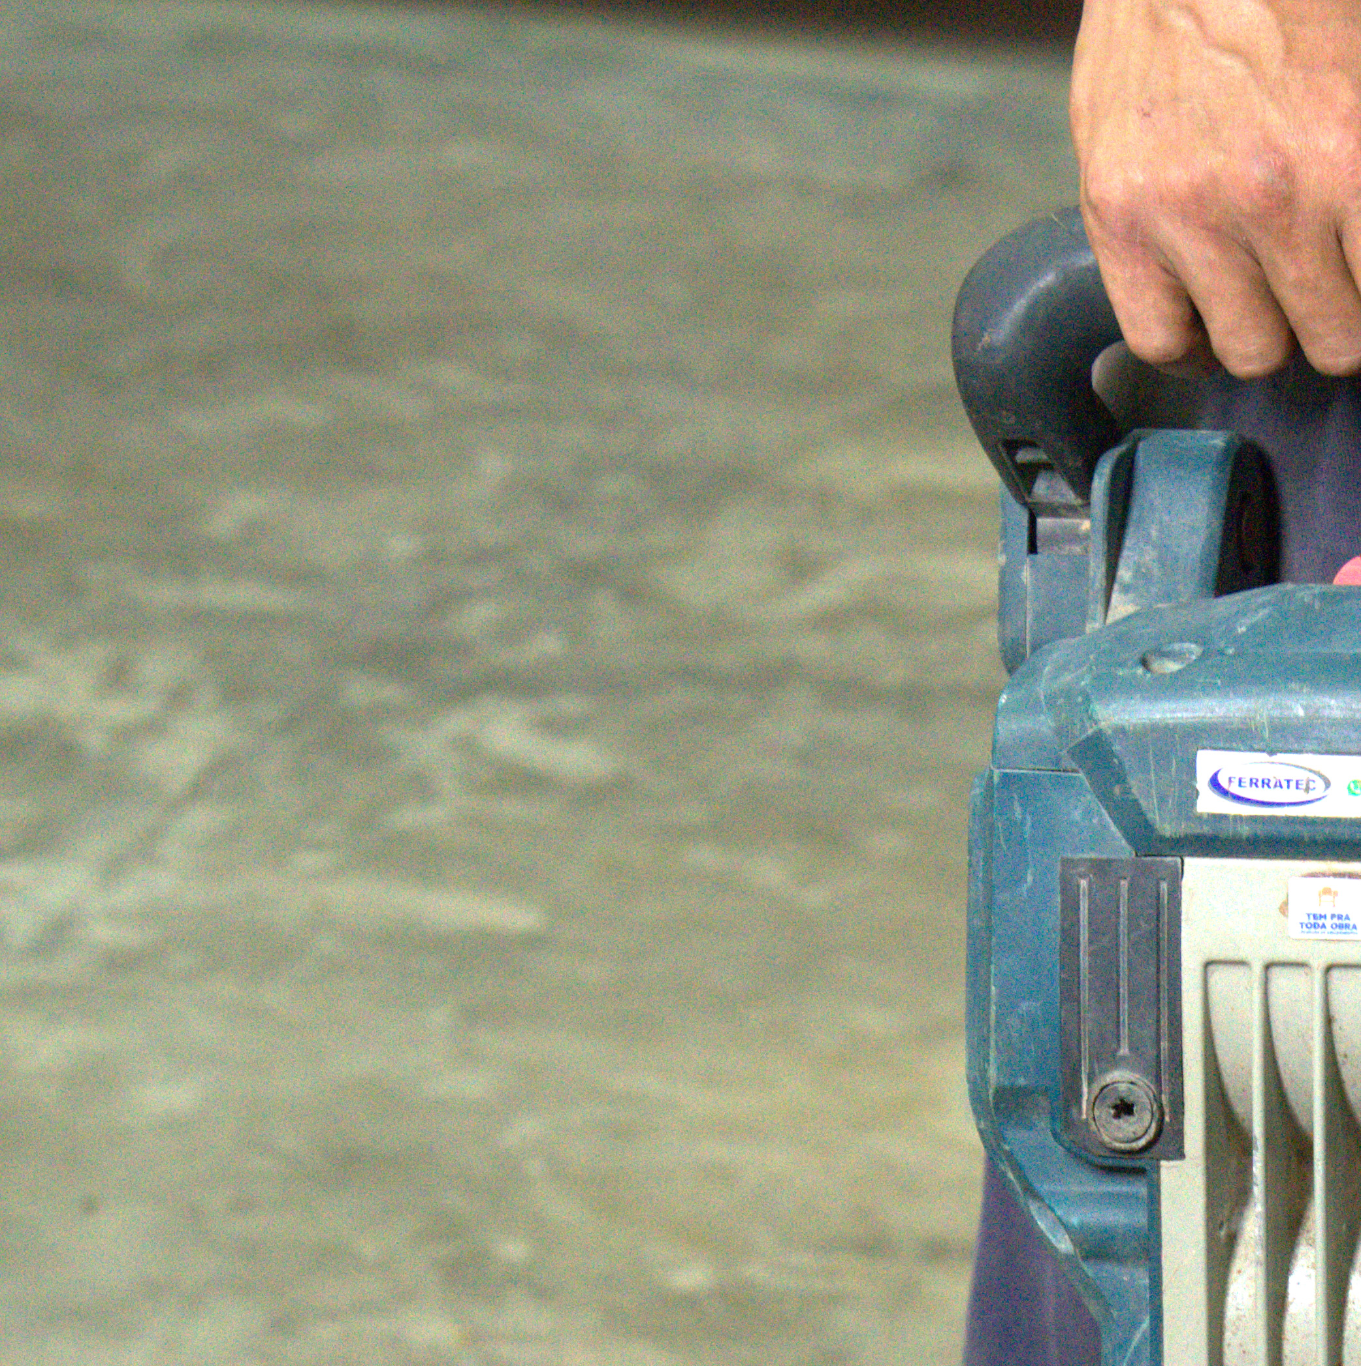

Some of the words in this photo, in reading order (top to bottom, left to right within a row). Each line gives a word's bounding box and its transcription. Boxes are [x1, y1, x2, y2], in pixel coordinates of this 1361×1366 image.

[1227, 776, 1317, 791] FERRATEC
[1305, 912, 1328, 921] TEM
[1330, 912, 1351, 922] PRA
[1299, 921, 1327, 930] TODA
[1330, 922, 1358, 931] OBRA
